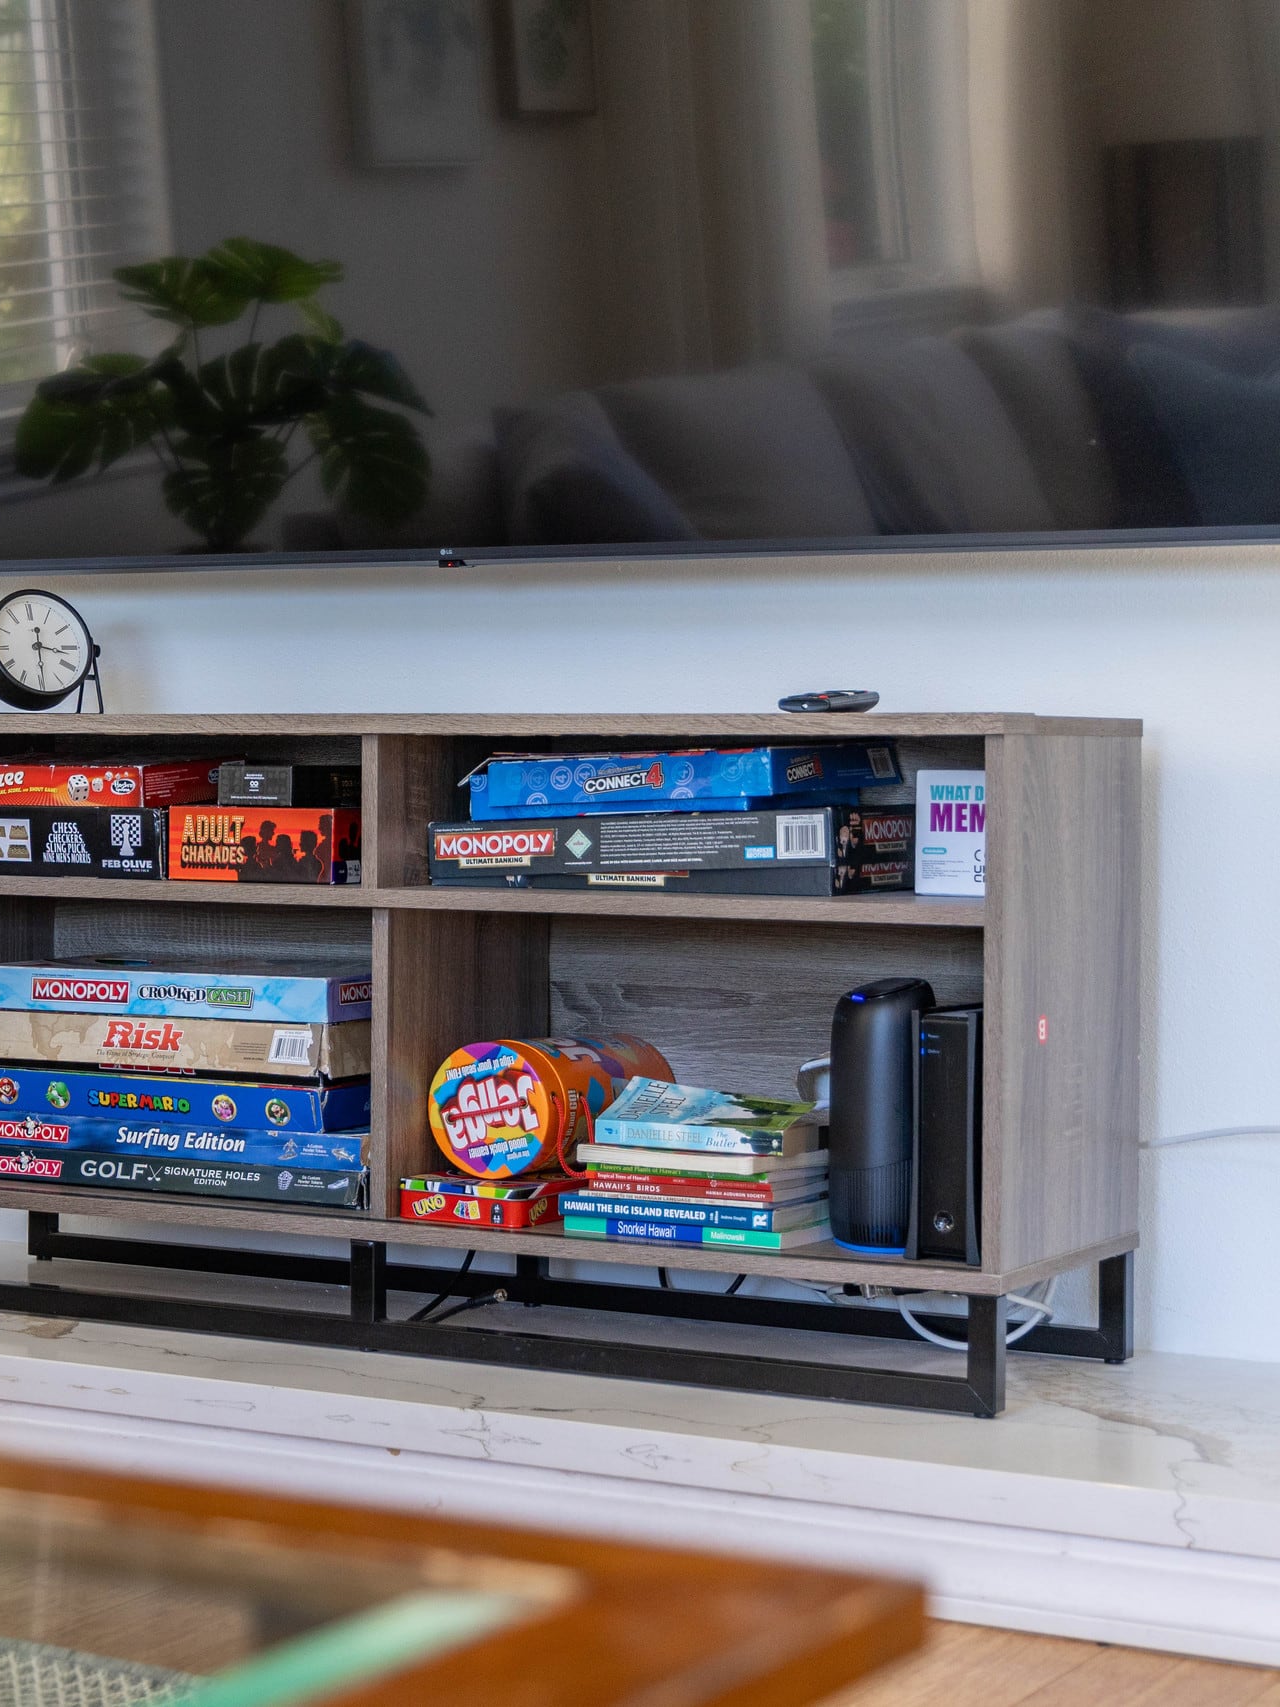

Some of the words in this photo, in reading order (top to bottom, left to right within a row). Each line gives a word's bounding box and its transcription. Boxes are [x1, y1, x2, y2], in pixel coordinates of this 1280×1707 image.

[585, 772, 648, 792] CONNECT
[646, 763, 662, 787] 4
[786, 762, 815, 781] CONNECT
[929, 785, 972, 801] WHAT
[52, 822, 80, 834] CHESS.
[181, 814, 245, 844] ADULT
[864, 819, 913, 841] MONOPOLY
[46, 842, 67, 853] SLING
[68, 843, 88, 853] PUCK.
[48, 833, 85, 844] CHECKERS.
[439, 833, 551, 856] MONOPOLY
[43, 852, 55, 862] NINE
[56, 853, 71, 863] MEN'S
[71, 853, 91, 864] MORRIS
[102, 860, 121, 868] FEB
[122, 859, 153, 869] OLIVE
[181, 845, 245, 864] CHARADES
[465, 857, 494, 865] ULTIMATE
[495, 856, 523, 864] BANKING
[35, 981, 127, 1001] MONOPOLY
[139, 985, 206, 1002] CROOKED
[210, 990, 248, 1003] CASH
[102, 1020, 184, 1052] Risk
[88, 1089, 138, 1109] SUPER
[139, 1094, 190, 1113] MARIO
[618, 1081, 669, 1120] DANIELLE
[649, 1097, 687, 1116] STEEL
[441, 1073, 539, 1150] Jenga
[116, 1126, 180, 1151] Surfing
[184, 1131, 246, 1153] Edition
[627, 1127, 674, 1141] DANIELLE
[676, 1131, 702, 1143] STEEL
[705, 1137, 738, 1149] Butler
[80, 1159, 148, 1180] GOLF
[164, 1166, 222, 1178] SIGNATURE
[225, 1170, 261, 1181] HOLES
[194, 1178, 227, 1187] EDITION
[593, 1182, 631, 1191] HAWAII'S
[636, 1184, 660, 1192] BIRDS
[414, 1194, 445, 1216] UNO
[529, 1198, 547, 1223] UNO
[564, 1200, 595, 1212] HAWAII
[596, 1203, 613, 1213] THE
[614, 1204, 629, 1214] BIG
[631, 1206, 662, 1217] ISLAND
[664, 1208, 706, 1220] REVEALED
[618, 1221, 647, 1236] Snorkel
[710, 1231, 745, 1242] Malinowski
